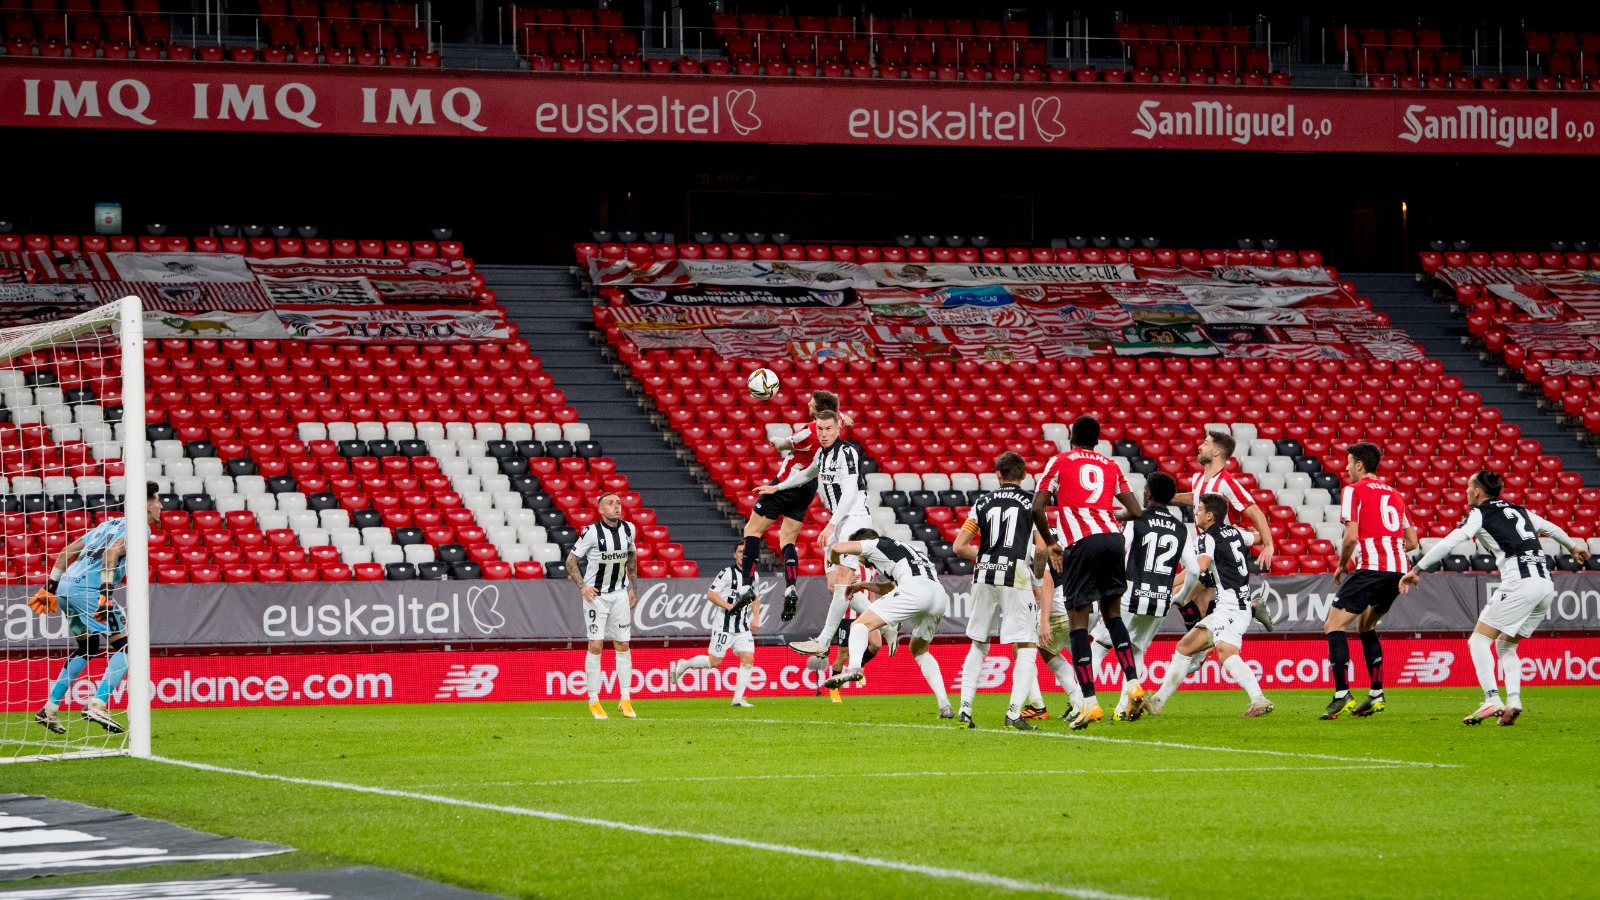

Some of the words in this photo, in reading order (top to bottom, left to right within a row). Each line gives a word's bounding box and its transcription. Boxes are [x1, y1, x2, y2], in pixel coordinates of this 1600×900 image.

[23, 78, 157, 126] IMQ
[192, 82, 323, 129] IMQ
[361, 86, 488, 132] IMQ
[535, 95, 719, 135] euskaltel
[848, 102, 1025, 141] euskaltel
[1302, 118, 1332, 140] 0,0
[1565, 120, 1595, 142] 0,0
[993, 491, 1032, 511] MORALES
[1079, 463, 1104, 504] 9
[986, 506, 1019, 549] 11
[1148, 518, 1176, 532] MALSA
[1380, 494, 1400, 532] 6
[1503, 507, 1536, 540] 2
[601, 552, 629, 561] betwa
[1141, 531, 1179, 576] 12
[1230, 539, 1249, 577] 5
[0, 603, 69, 640] au
[262, 593, 460, 637] euskaltel
[588, 609, 597, 623] 9
[717, 633, 728, 645] 10
[546, 661, 863, 696] newalance.co
